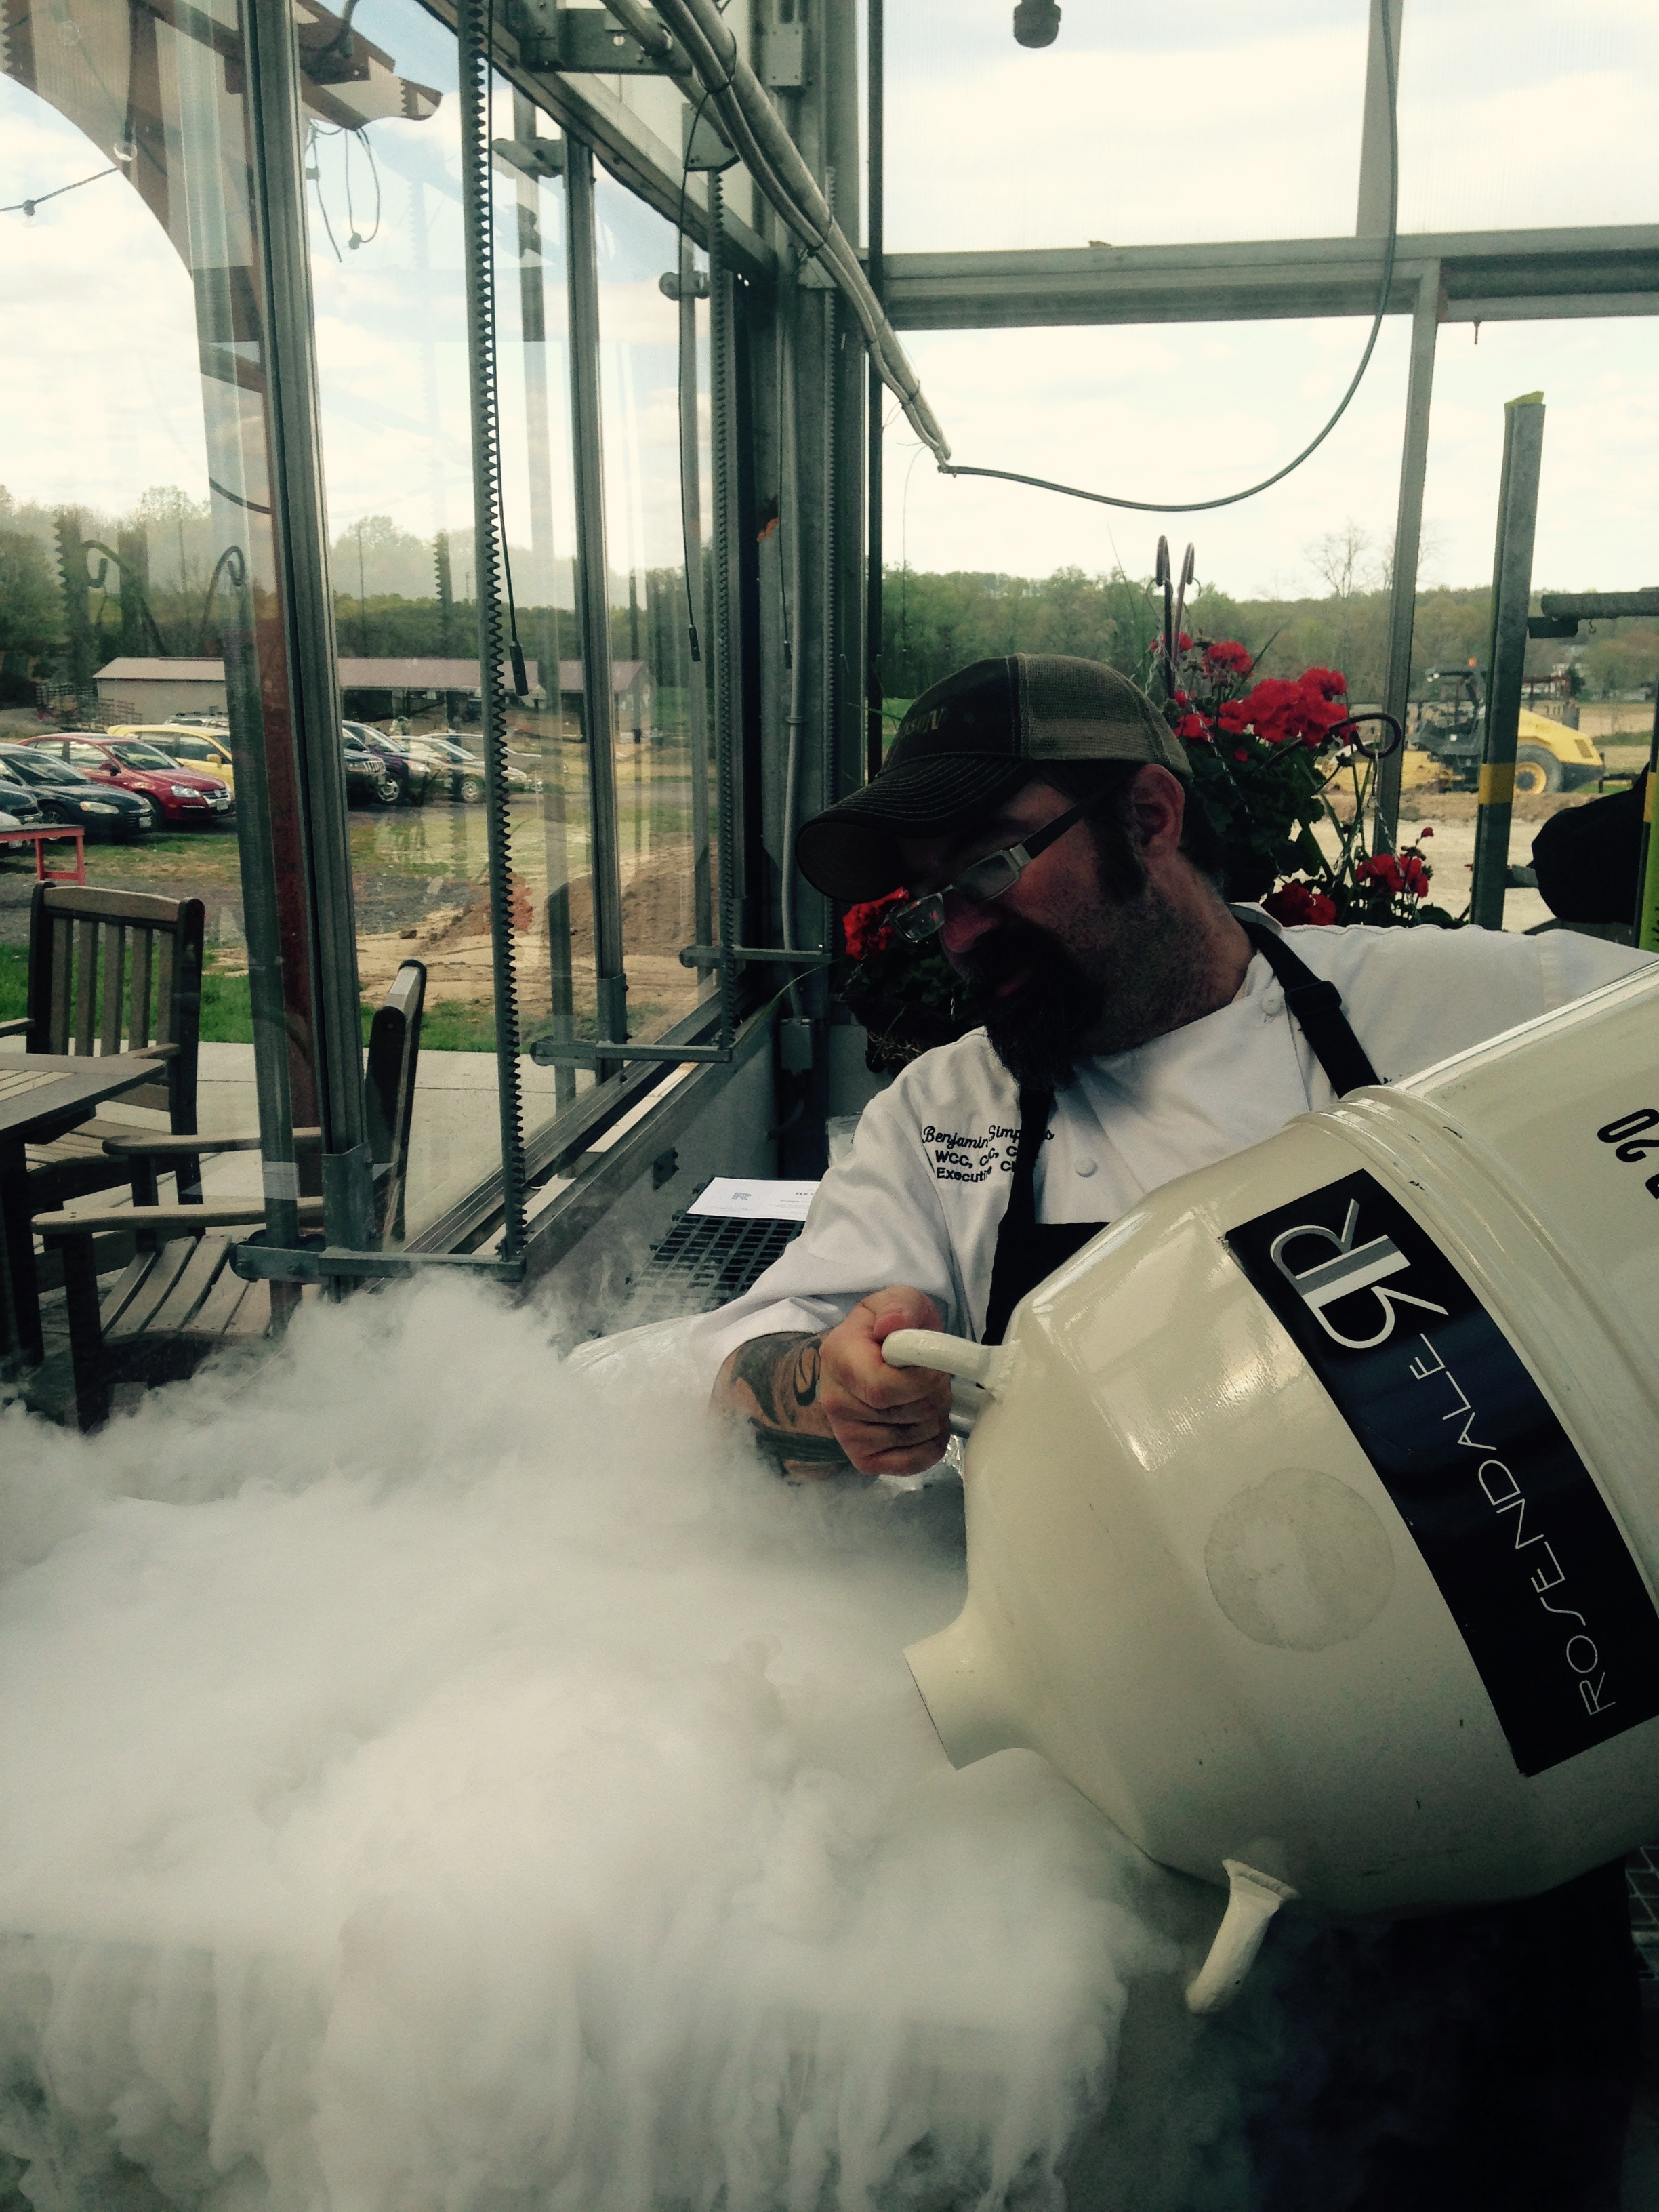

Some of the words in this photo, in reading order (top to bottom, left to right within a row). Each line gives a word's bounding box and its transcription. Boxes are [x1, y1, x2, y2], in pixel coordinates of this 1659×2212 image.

[922, 1125, 989, 1149] Benjamin
[935, 1149, 973, 1168] WCC,
[936, 1165, 992, 1183] Executie
[1408, 1332, 1617, 1716] ROSENDALE
